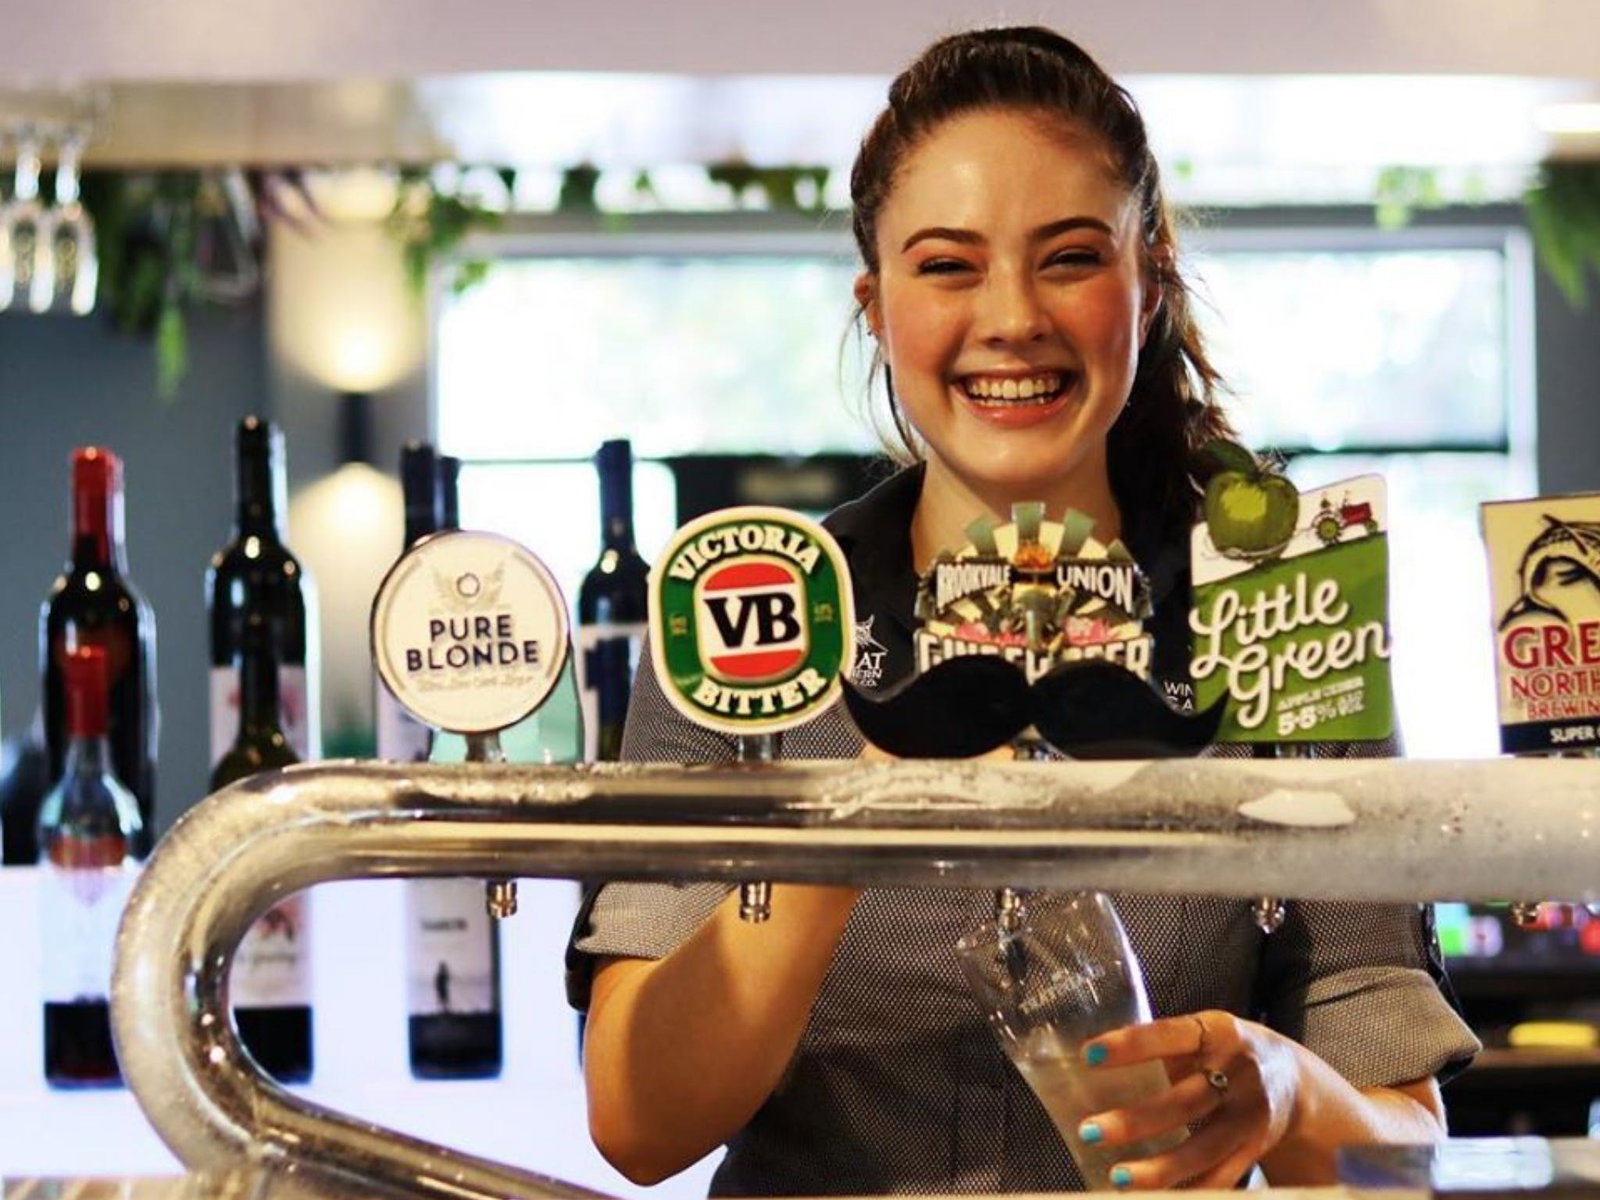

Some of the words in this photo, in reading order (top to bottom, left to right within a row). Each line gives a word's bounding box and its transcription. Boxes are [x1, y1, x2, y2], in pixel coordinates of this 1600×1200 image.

[669, 524, 820, 581] VICTORIA
[937, 563, 1012, 613] BROOKVALE
[1056, 564, 1133, 613] UNION
[429, 614, 512, 642] PURE
[703, 591, 801, 649] VB
[1188, 572, 1349, 679] Little
[406, 640, 539, 671] BLONDE
[1228, 621, 1390, 728] Green
[691, 667, 827, 714] BITTER
[1549, 725, 1596, 743] SUPER
